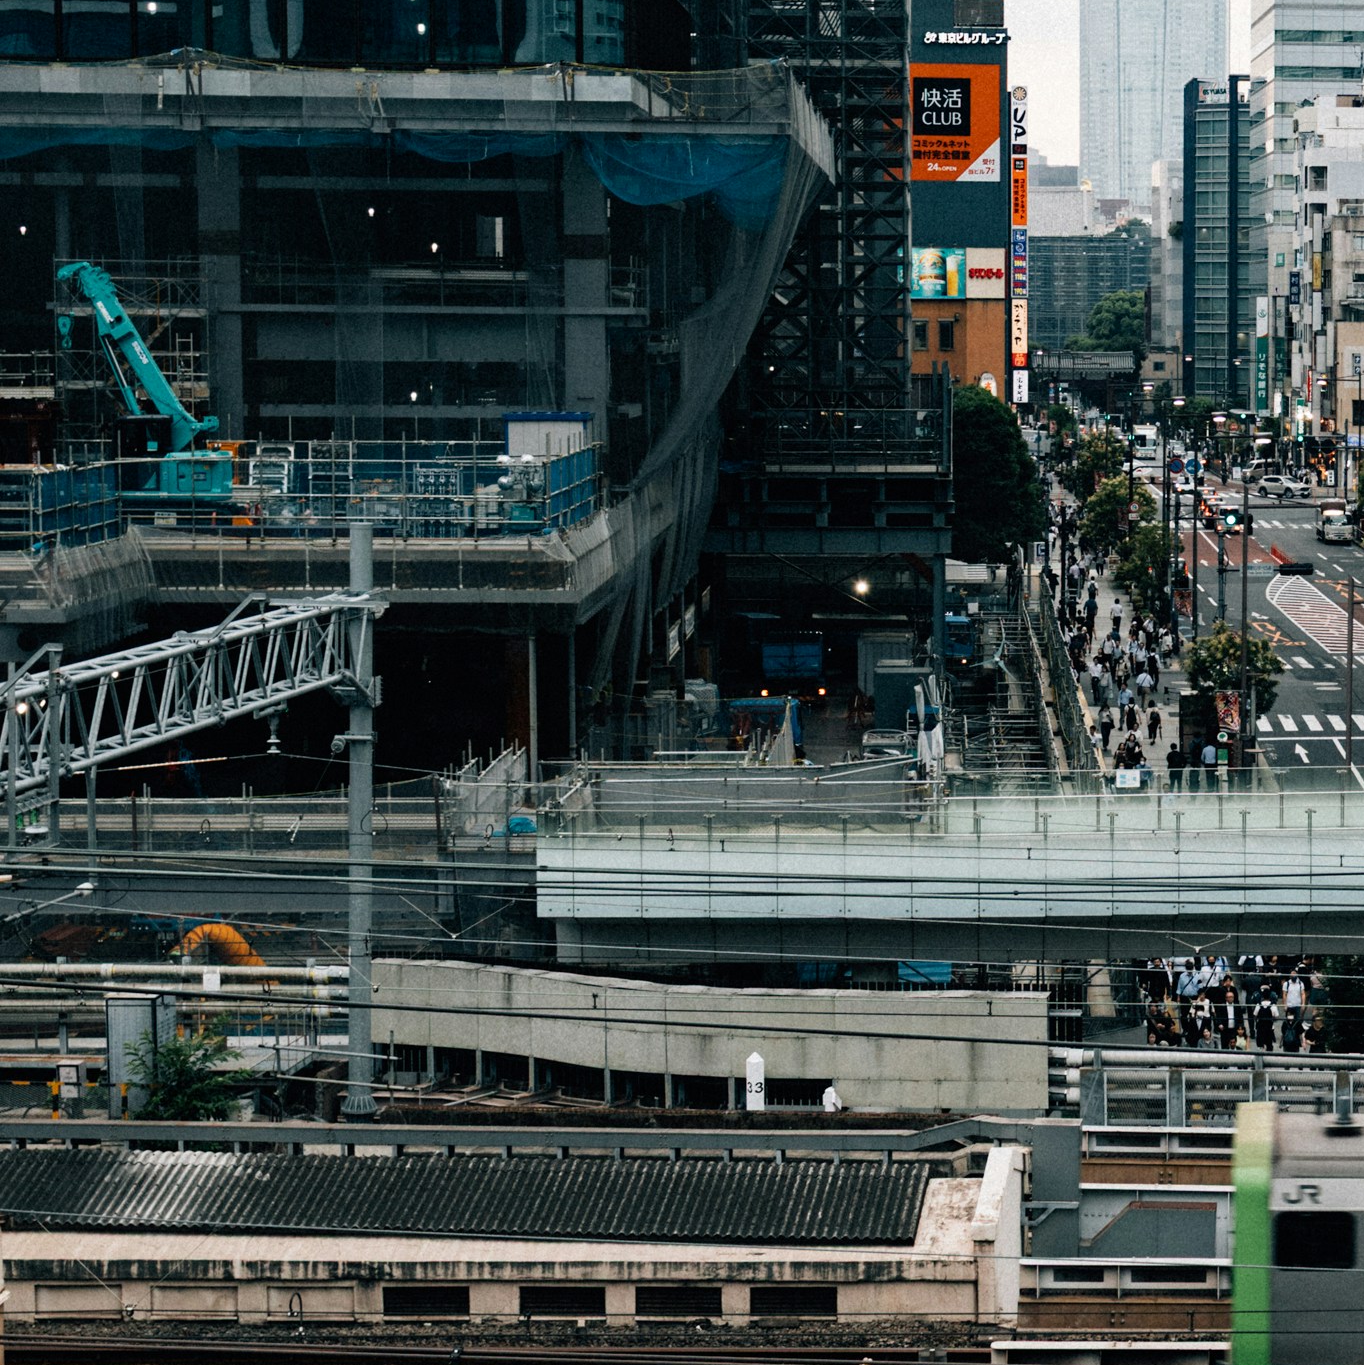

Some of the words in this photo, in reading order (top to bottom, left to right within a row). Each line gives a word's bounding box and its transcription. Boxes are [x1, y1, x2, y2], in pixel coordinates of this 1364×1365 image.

[938, 32, 1006, 44] 東京ビルグループ
[920, 88, 962, 108] 快活
[921, 111, 962, 126] CLUB
[982, 158, 995, 166] 受付
[1257, 353, 1267, 399] りそな銀行
[747, 1081, 764, 1094] 33
[1281, 1184, 1322, 1205] JR
